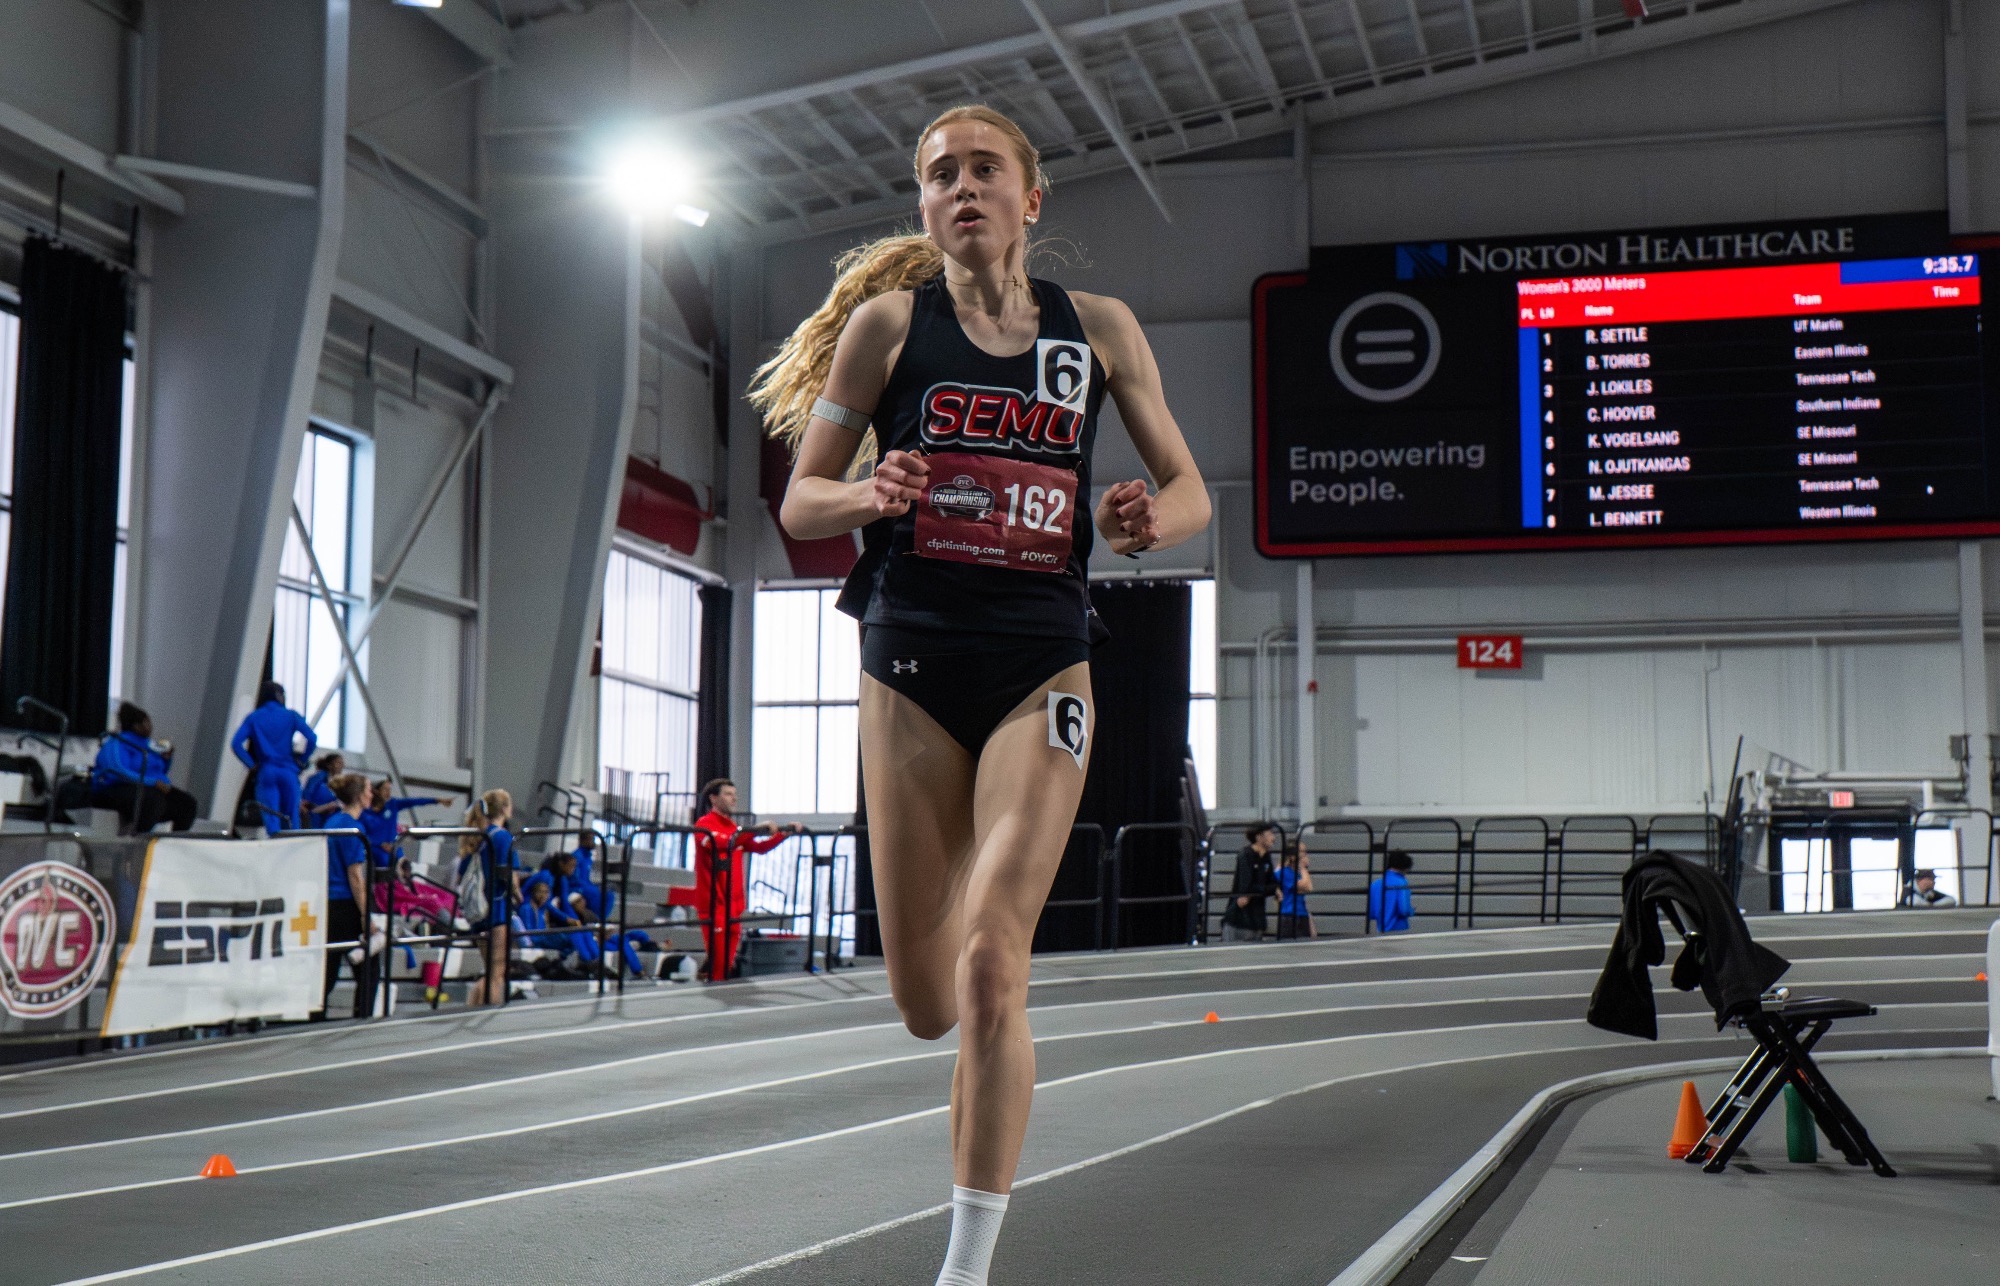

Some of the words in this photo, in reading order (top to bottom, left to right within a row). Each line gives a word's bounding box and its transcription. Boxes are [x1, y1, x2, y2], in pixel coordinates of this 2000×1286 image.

[1458, 242, 1607, 274] NORTON
[1619, 227, 1854, 265] HEALTHCARE
[1922, 255, 1974, 275] 9:35.7
[1517, 280, 1569, 295] Women's
[1572, 277, 1602, 293] 3000
[1604, 277, 1646, 290] Meters
[1521, 307, 1535, 320] PL
[1585, 305, 1614, 317] Name
[1793, 294, 1822, 306] Team
[1932, 286, 1960, 298] Time
[1543, 332, 1551, 346] 1
[1586, 329, 1598, 344] R.
[1600, 327, 1648, 343] SETTLE
[1793, 320, 1808, 333] UT
[1810, 318, 1844, 332] Martin
[1544, 358, 1553, 372] 2
[1586, 355, 1599, 371] B.
[1601, 353, 1650, 369] TORRES
[1794, 346, 1833, 360] Eastern
[1834, 344, 1869, 358] Illinois
[1045, 345, 1082, 403] 6
[1544, 384, 1553, 397] 3
[1586, 382, 1599, 396] J.
[1796, 372, 1849, 386] Tennessee
[1850, 369, 1876, 383] Tech
[1545, 410, 1554, 424] 4
[1587, 407, 1600, 422] C.
[1603, 405, 1656, 422] HOOVER
[1796, 398, 1842, 412] Southern
[1842, 397, 1882, 411] Indiana
[1545, 436, 1554, 450] 5
[1588, 434, 1601, 448] K.
[1603, 431, 1680, 448] VOGELSANG
[1797, 426, 1812, 440] SE
[1812, 424, 1857, 439] Missouri
[1290, 440, 1486, 474] Empowering
[1546, 462, 1555, 476] 6
[1588, 459, 1602, 475] N.
[1798, 453, 1813, 466] SE
[1813, 451, 1858, 465] Missouri
[933, 493, 991, 507] CHAMPIONSHIP
[1290, 476, 1405, 507] People.
[1546, 488, 1556, 502] 7
[1589, 486, 1605, 501] M.
[1607, 484, 1655, 500] JESSEE
[1799, 479, 1853, 493] Tennessee
[1853, 476, 1880, 491] Tech
[1004, 483, 1067, 534] 162
[1590, 513, 1602, 527] L.
[1604, 510, 1663, 526] BENNETT
[1799, 505, 1841, 520] Western
[1842, 504, 1877, 518] Illinois
[927, 538, 1005, 556] cfpitiming.com
[1466, 641, 1514, 663] 124
[1056, 696, 1084, 756] 6
[16, 911, 81, 970] OVC
